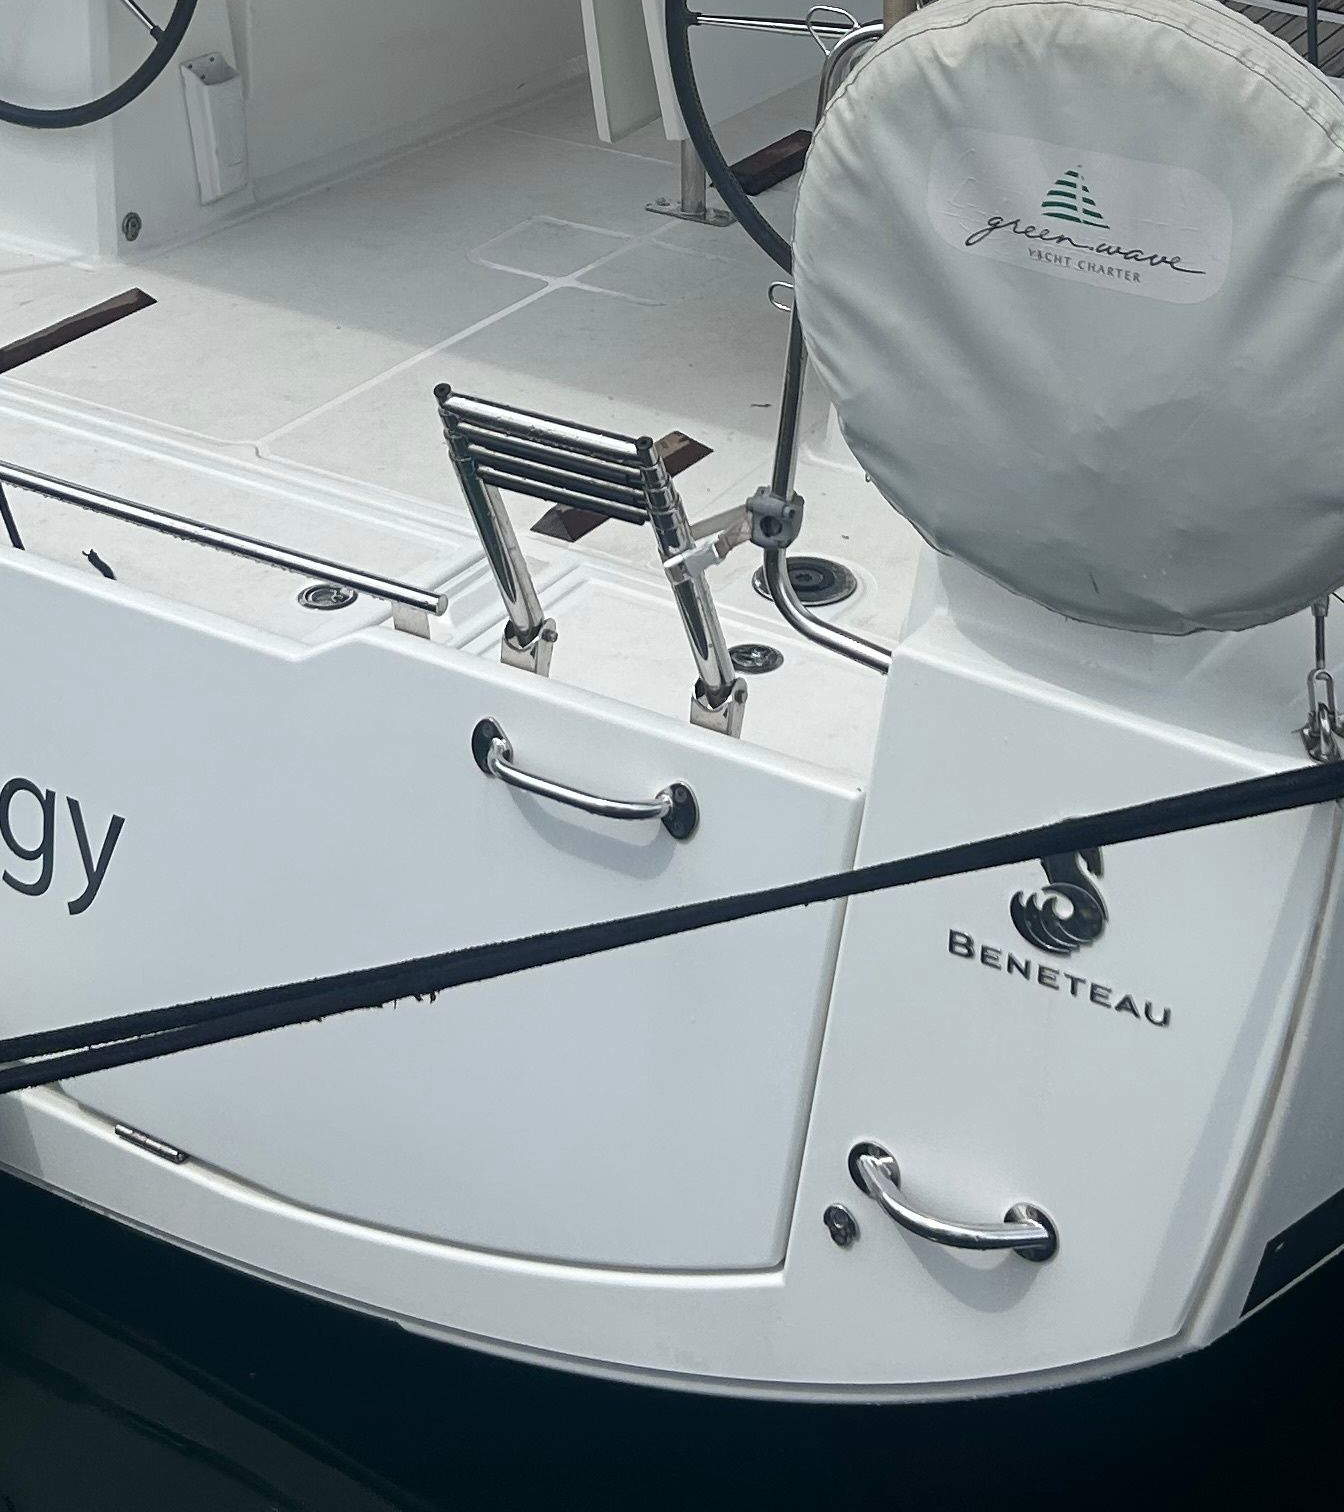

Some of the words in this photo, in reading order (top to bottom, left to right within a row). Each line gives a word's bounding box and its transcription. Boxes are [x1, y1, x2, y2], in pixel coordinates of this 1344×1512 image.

[1028, 248, 1073, 268] YACHT
[1078, 260, 1142, 284] CHARTER
[948, 928, 1172, 1028] BENETEAU
